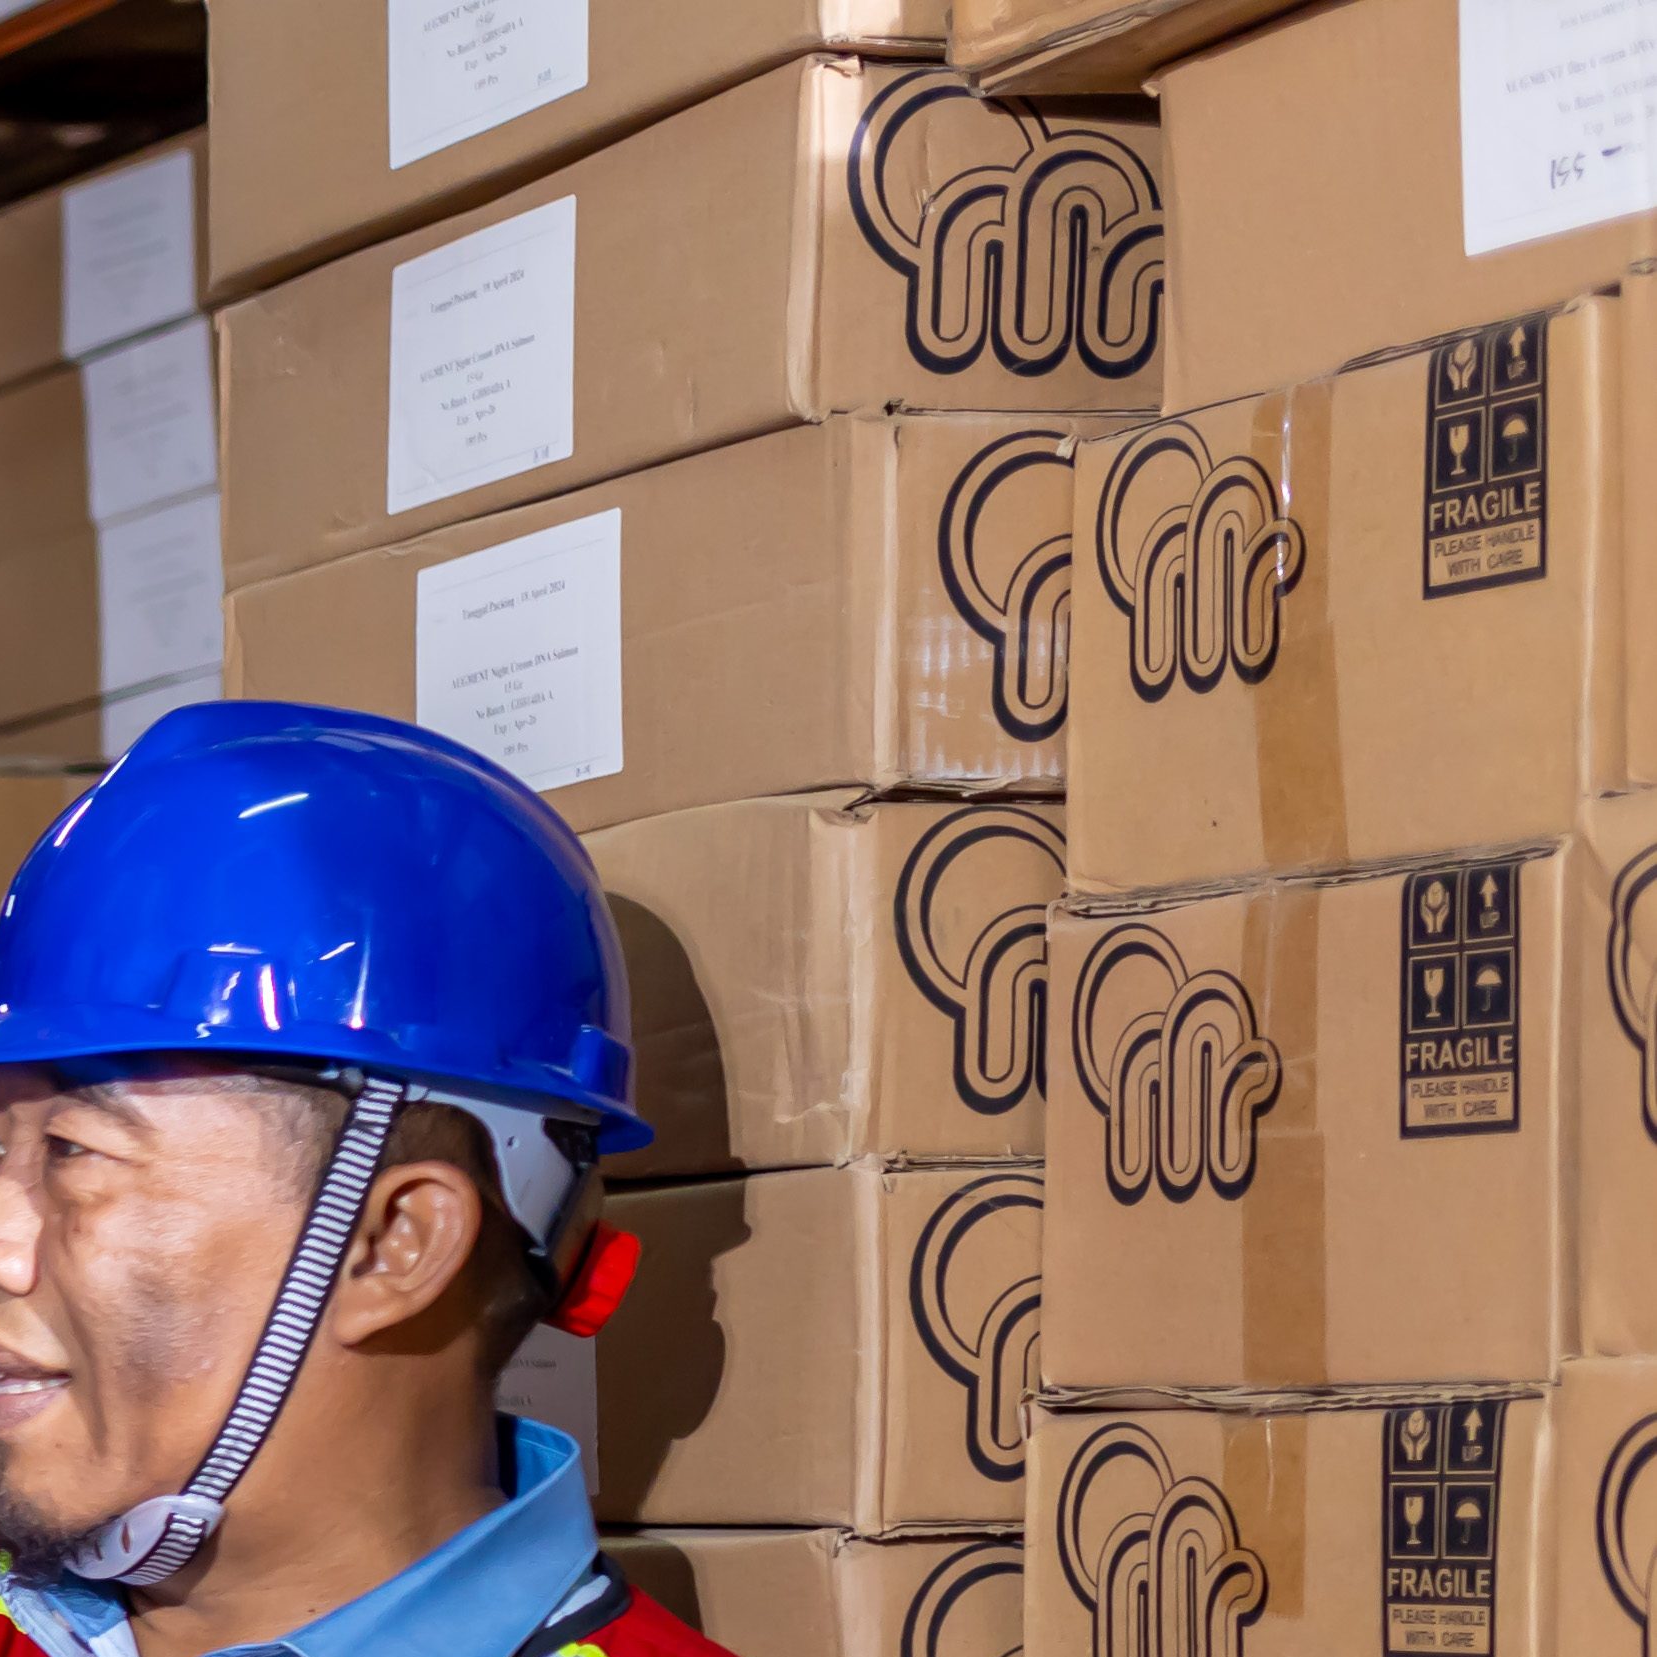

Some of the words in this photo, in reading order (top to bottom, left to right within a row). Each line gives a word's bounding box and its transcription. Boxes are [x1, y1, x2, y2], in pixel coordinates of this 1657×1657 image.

[1429, 481, 1542, 532] FRAGILE
[1405, 1034, 1515, 1073] FRAGILE
[1386, 1567, 1492, 1599] FRAGILE
